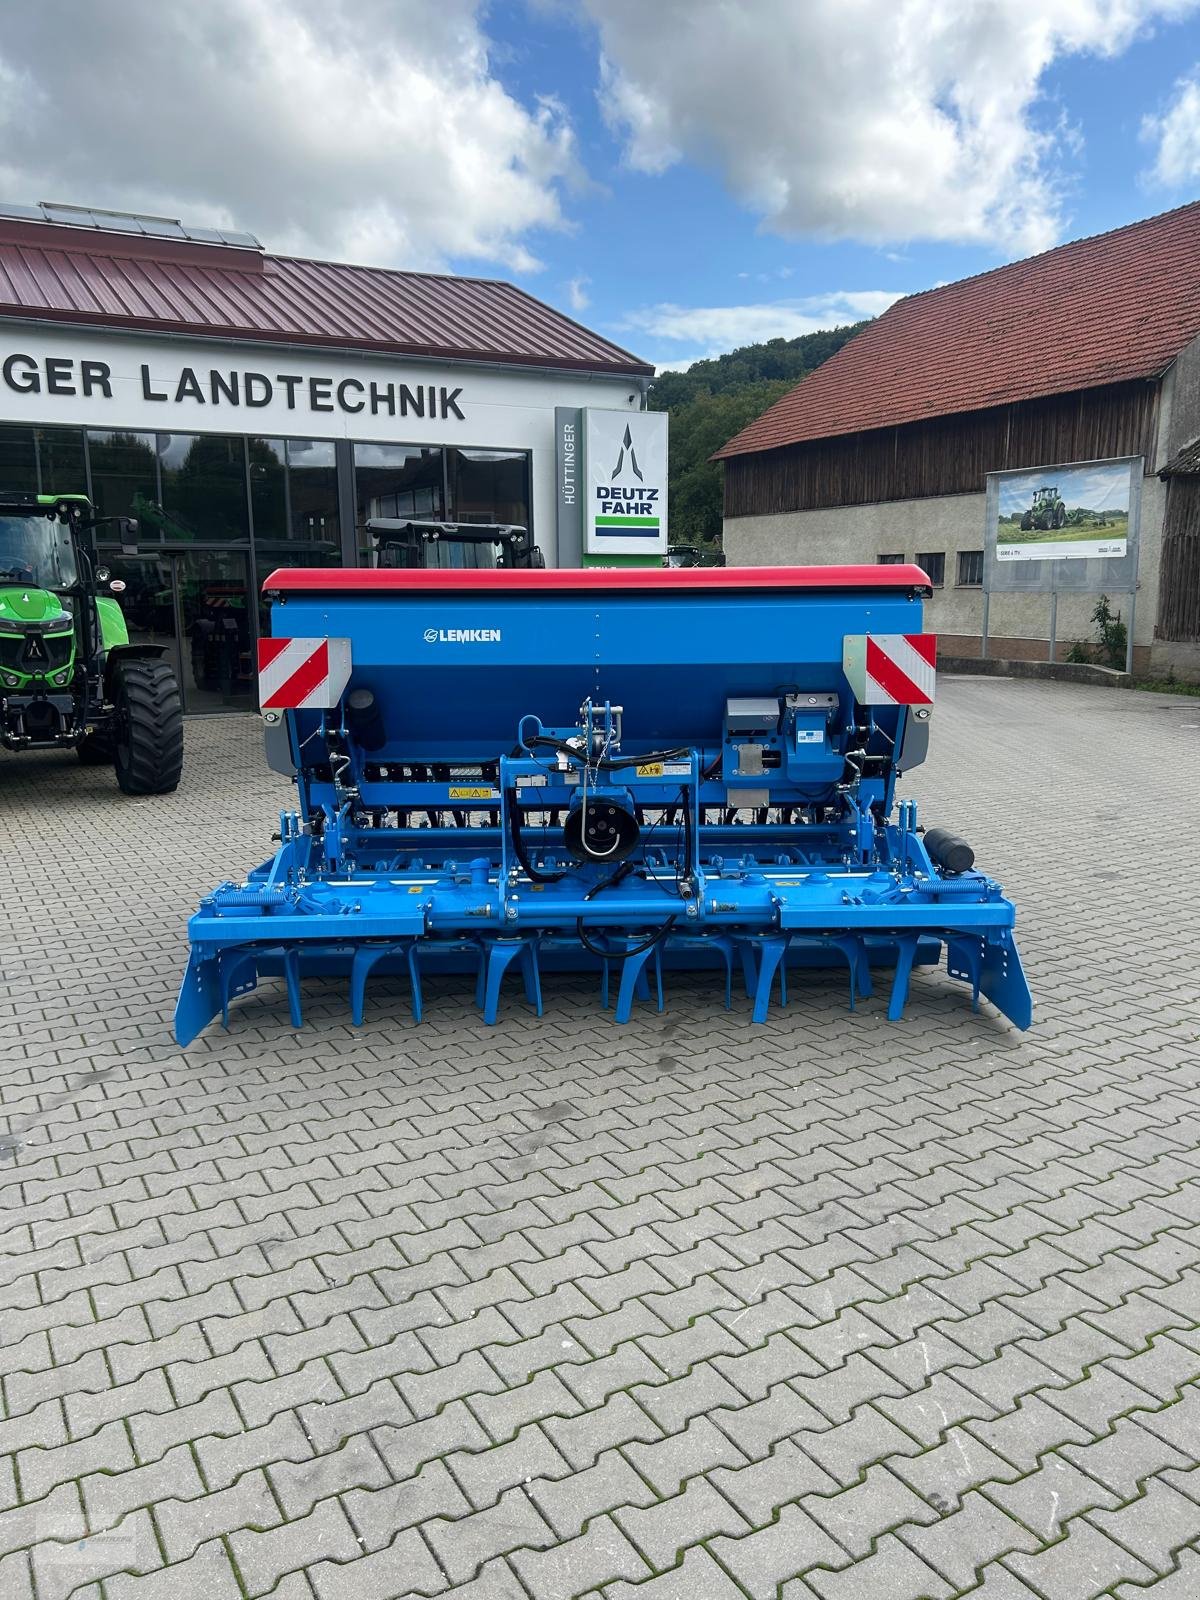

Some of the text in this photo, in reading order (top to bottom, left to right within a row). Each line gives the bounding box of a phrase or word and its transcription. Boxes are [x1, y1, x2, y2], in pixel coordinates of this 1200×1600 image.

[3, 353, 466, 420] GER LANDTECHNIK
[561, 423, 575, 505] HÜTTINGER
[596, 486, 659, 501] DEUTZ
[601, 501, 653, 515] FAHR
[439, 629, 501, 644] LEMKEN
